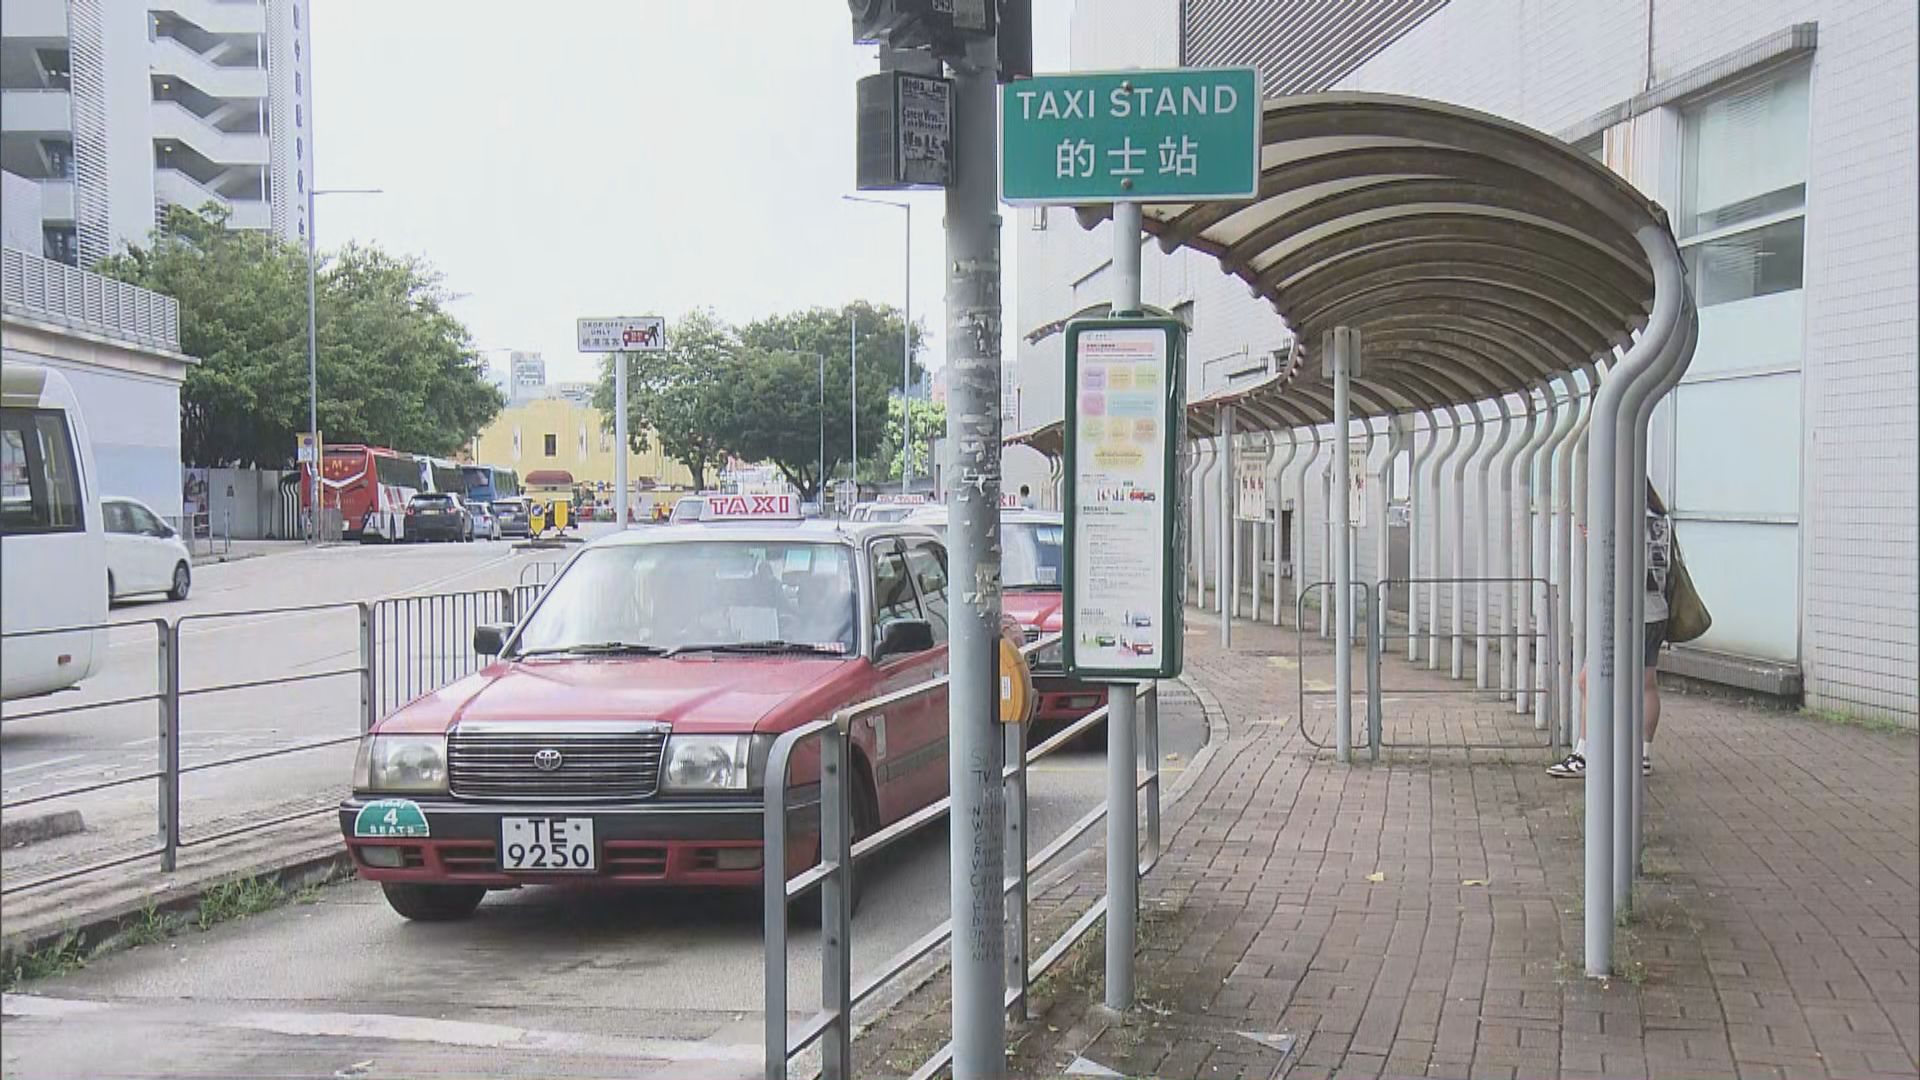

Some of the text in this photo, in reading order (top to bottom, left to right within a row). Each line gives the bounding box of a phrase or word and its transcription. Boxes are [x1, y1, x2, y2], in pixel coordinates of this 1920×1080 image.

[1016, 84, 1238, 120] TAXI STAND
[1056, 135, 1199, 179] 的士站
[709, 496, 789, 514] TAXI
[369, 824, 415, 834] SEATS
[383, 808, 398, 826] 4
[528, 817, 568, 843] TE
[508, 843, 590, 868] 9250
